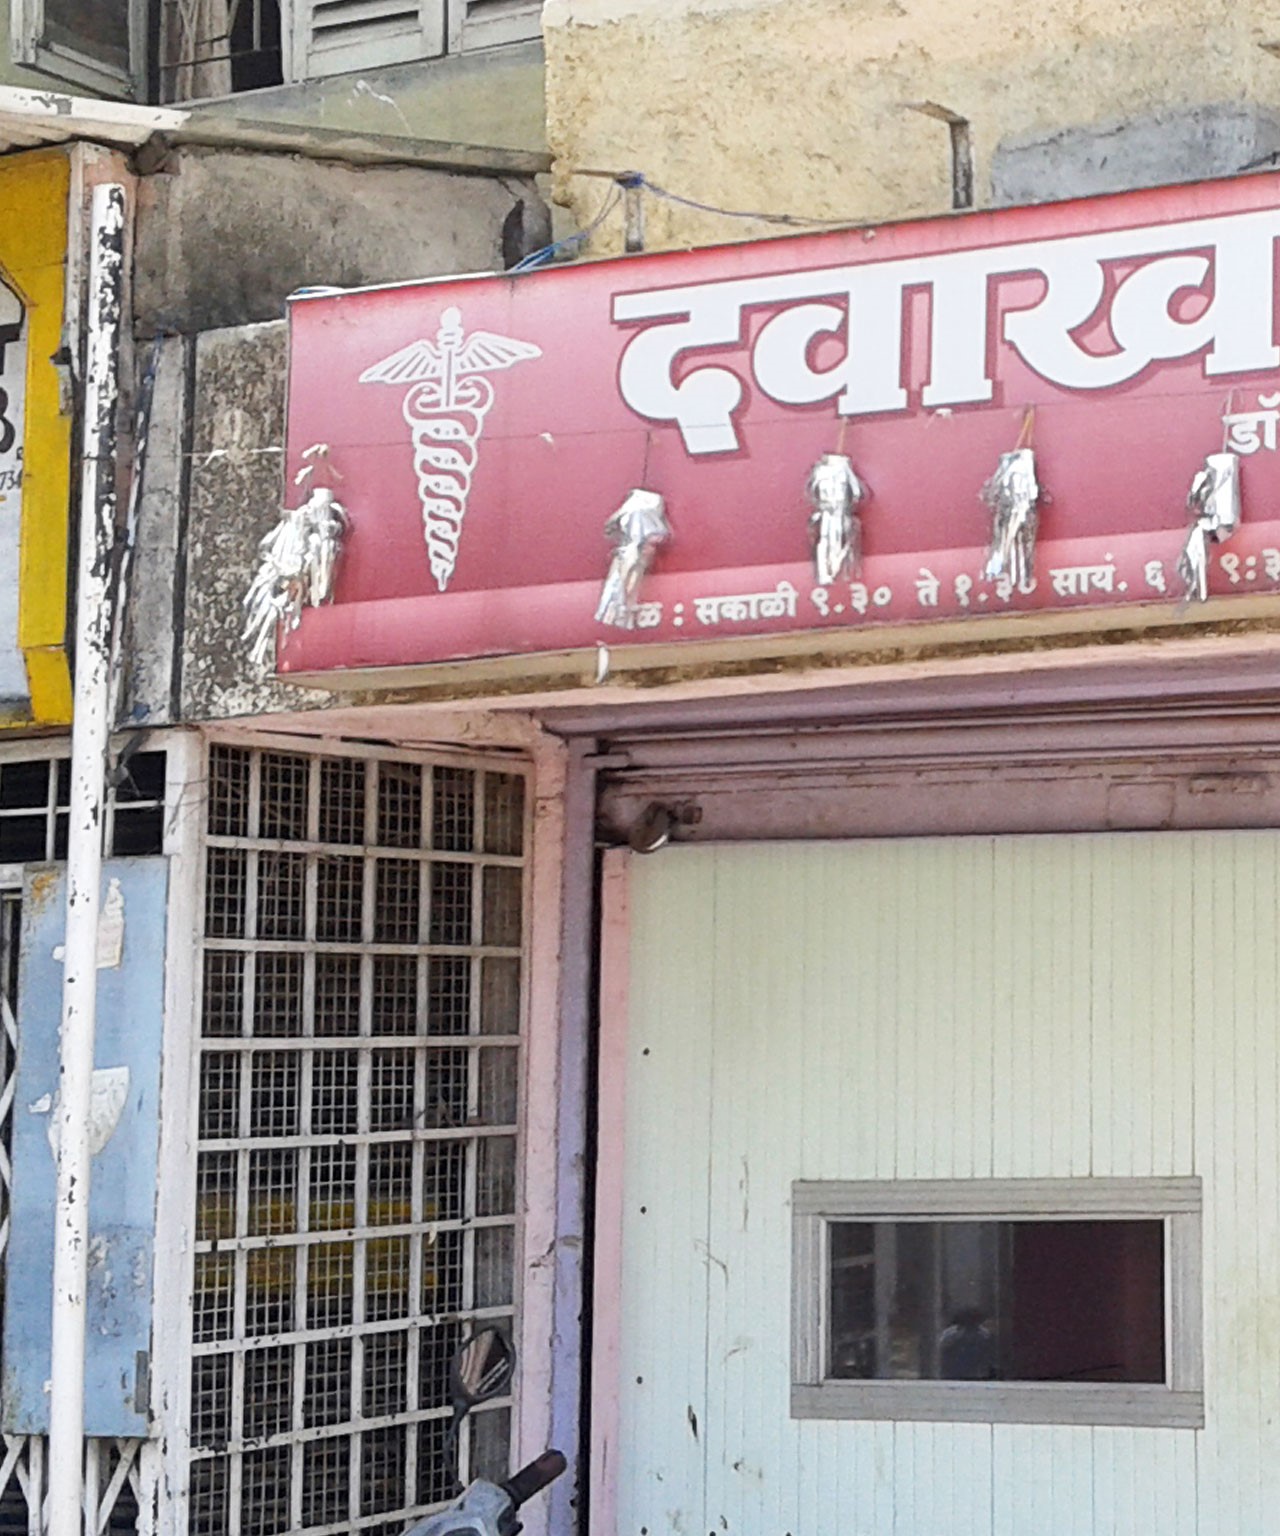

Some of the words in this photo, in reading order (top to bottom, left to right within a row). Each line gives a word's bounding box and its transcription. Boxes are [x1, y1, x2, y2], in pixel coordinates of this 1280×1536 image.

[693, 580, 799, 625] सकाळी
[915, 567, 941, 607] ते
[1049, 552, 1128, 597] सायं.
[1144, 560, 1167, 592] ६
